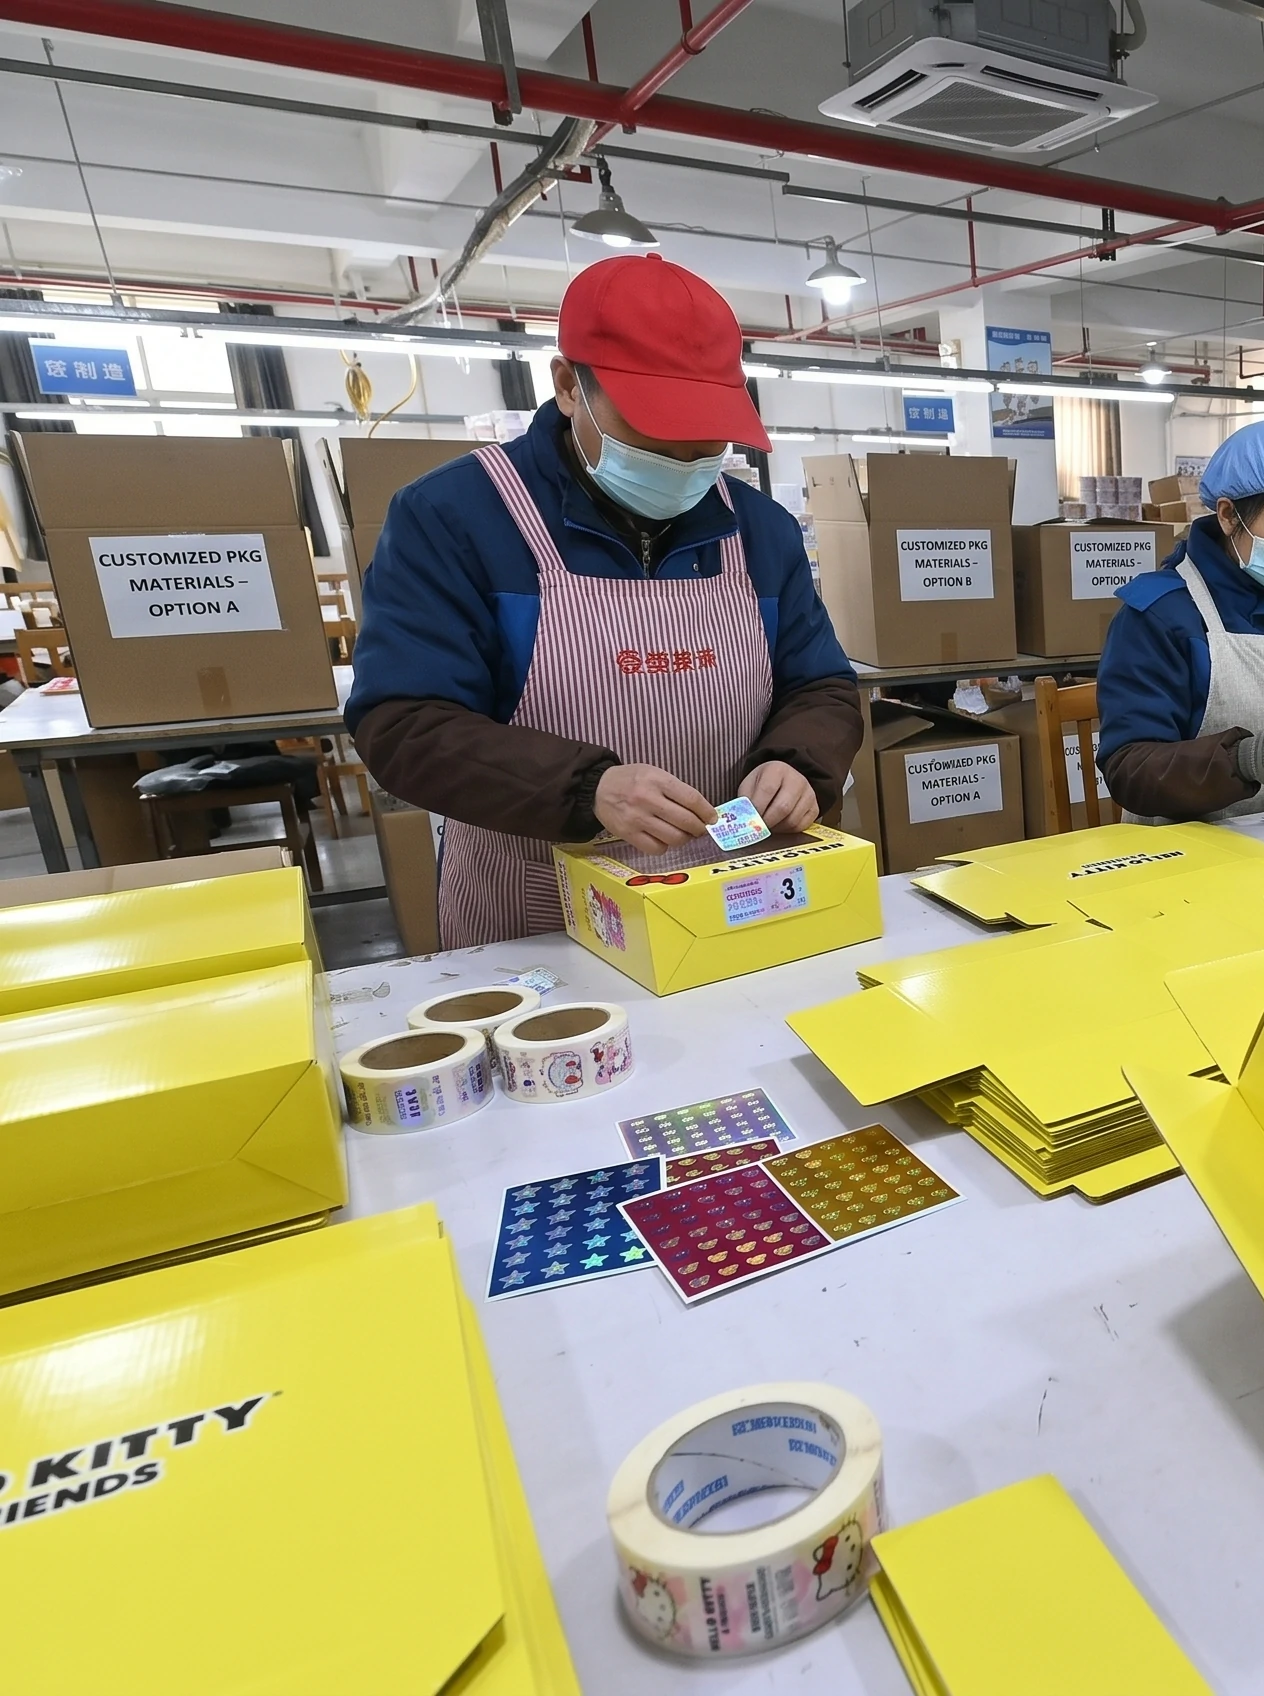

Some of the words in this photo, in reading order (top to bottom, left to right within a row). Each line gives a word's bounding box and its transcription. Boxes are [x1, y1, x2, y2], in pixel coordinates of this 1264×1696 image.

[900, 540, 966, 551] CUSTOMIZED
[968, 540, 988, 551] PKG
[1074, 542, 1132, 553] CUSTOMIZED
[1134, 541, 1151, 551] PKG
[99, 551, 221, 567] CUSTOMIZED
[227, 550, 262, 563] PKG
[915, 558, 971, 569] MATERIALS
[1085, 558, 1135, 569] MATERIALS
[129, 575, 234, 592] MATERIALS
[923, 576, 964, 587] OPTION
[965, 576, 972, 586] B
[1091, 576, 1127, 586] OPTION
[149, 601, 221, 617] OPTION
[226, 600, 240, 613] A
[976, 754, 996, 766] PKG
[922, 774, 979, 790] MATERIALS
[931, 792, 971, 807] OPTION
[973, 791, 981, 800] A
[31, 1396, 264, 1488] KITTY
[0, 1462, 159, 1524] IENDS
